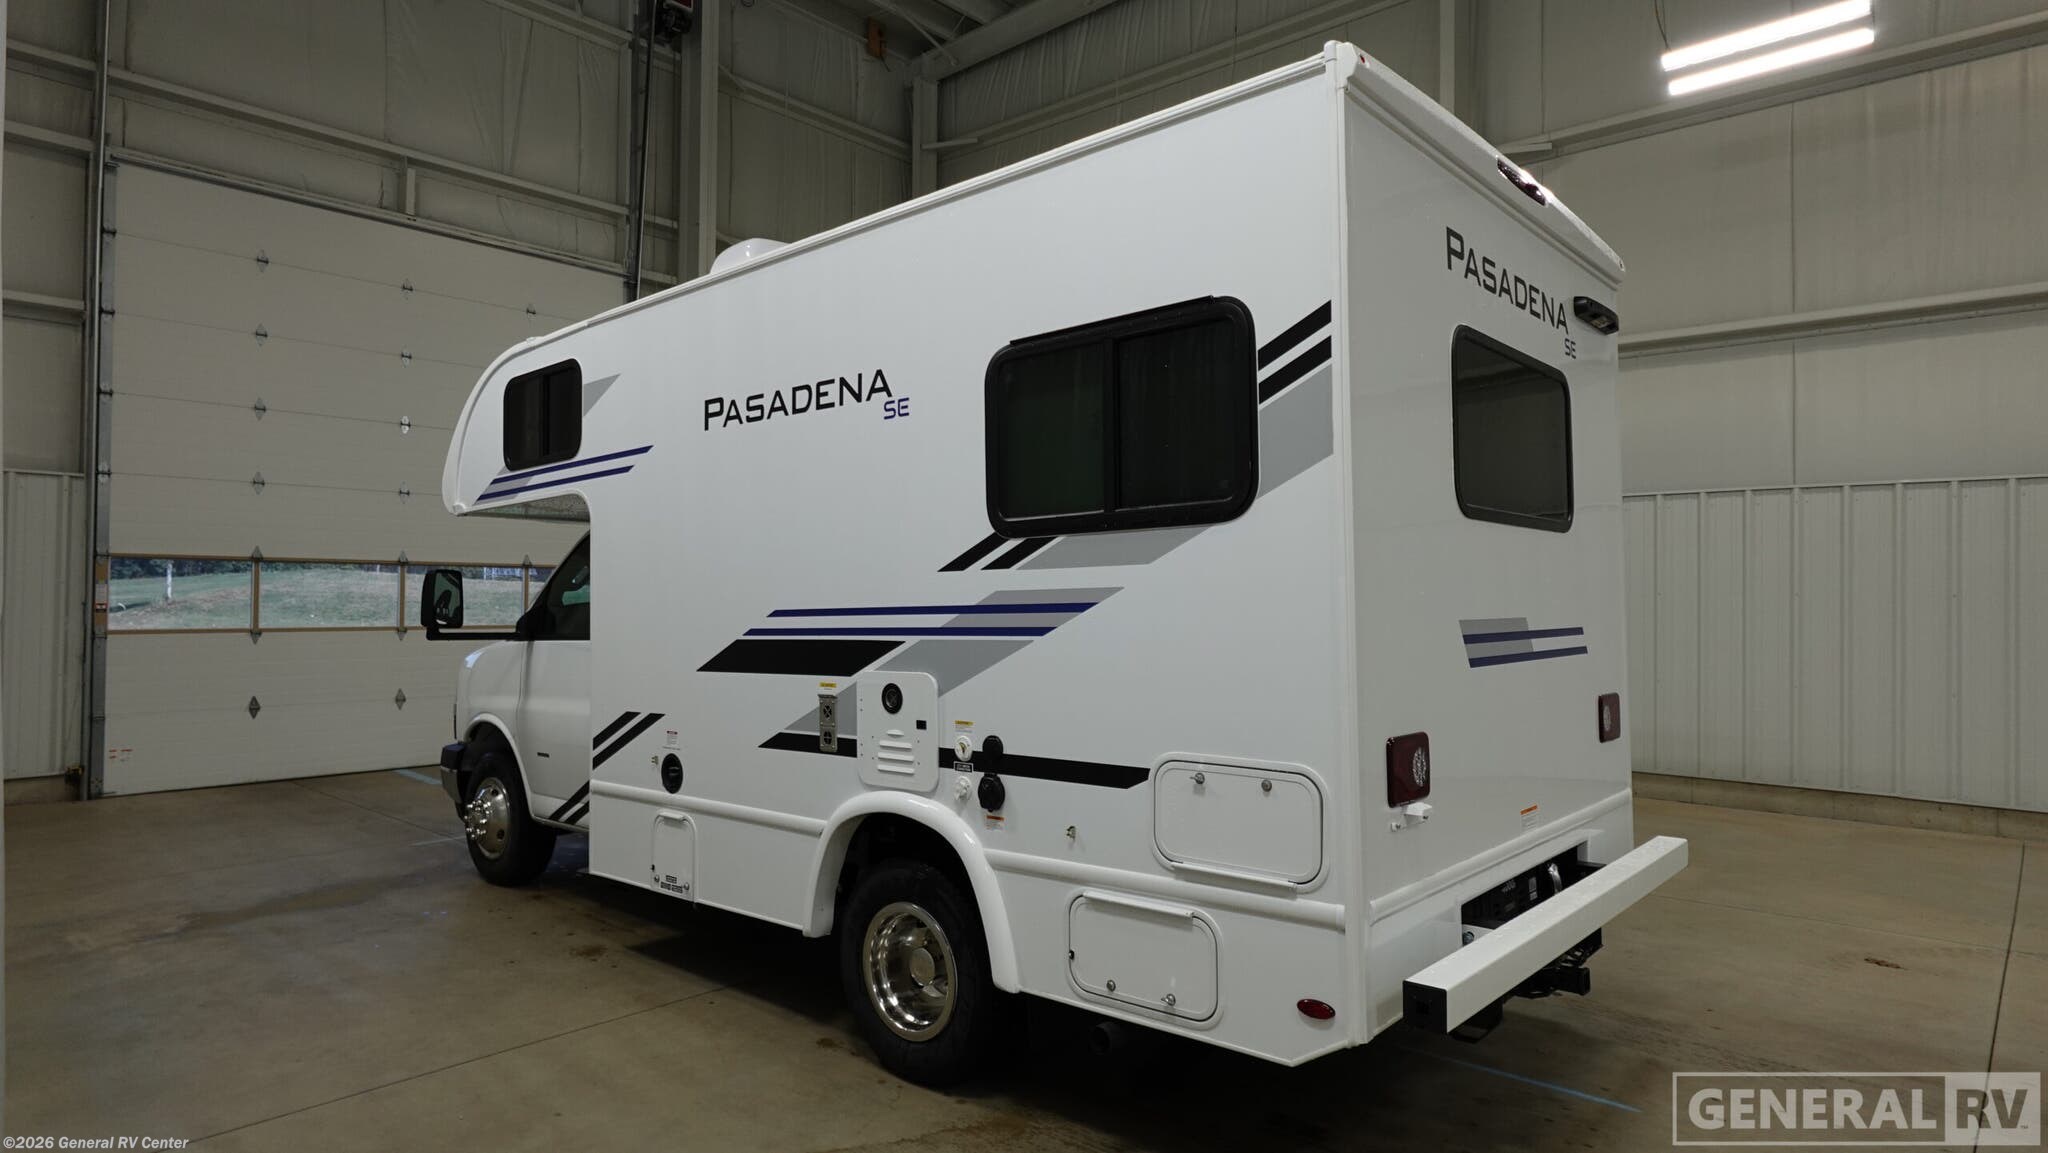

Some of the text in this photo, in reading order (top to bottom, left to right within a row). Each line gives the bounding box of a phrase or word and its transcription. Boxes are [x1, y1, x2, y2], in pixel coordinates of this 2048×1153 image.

[1446, 226, 1569, 335] PASADENA
[1564, 338, 1577, 359] SE
[704, 369, 893, 431] PASADENA
[883, 397, 910, 420] SE
